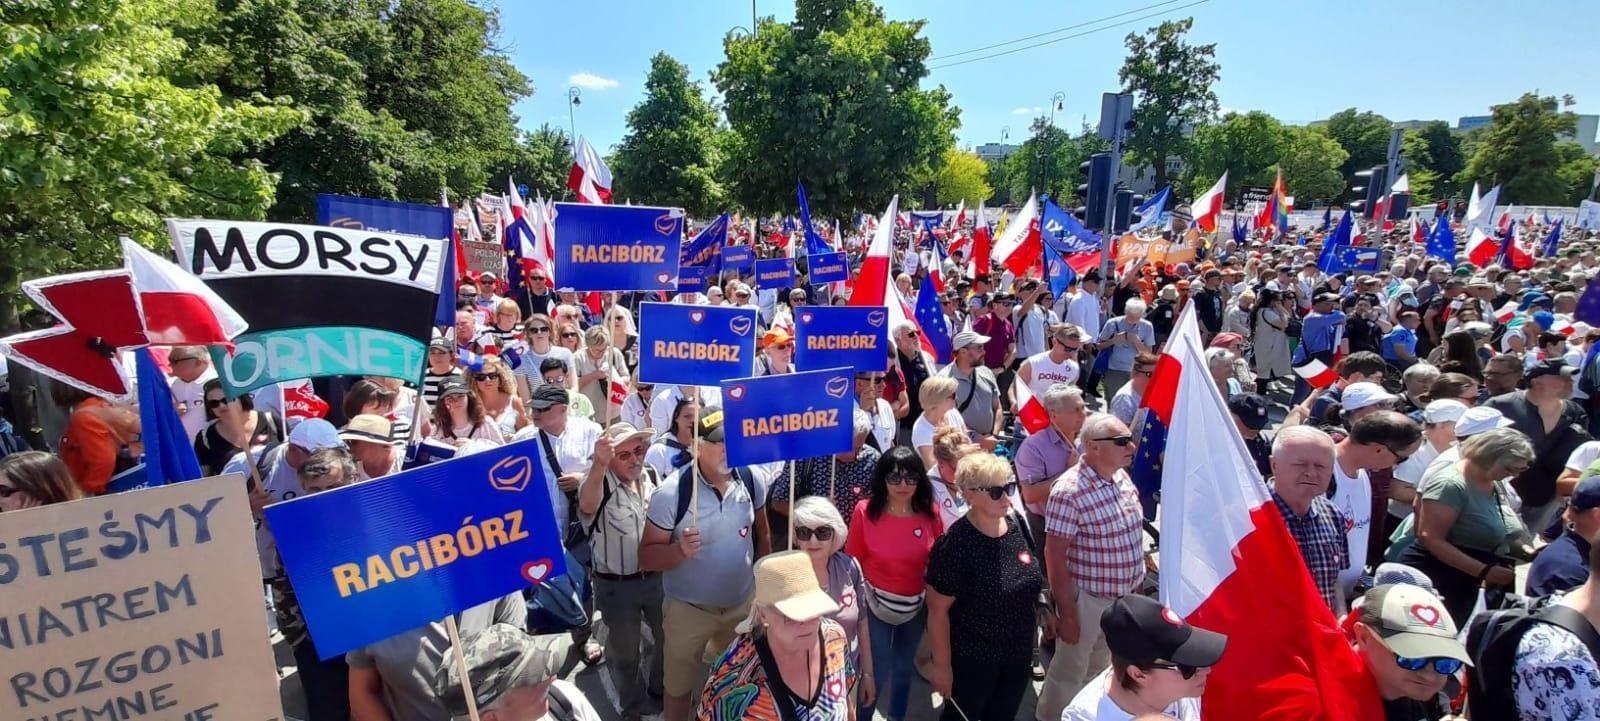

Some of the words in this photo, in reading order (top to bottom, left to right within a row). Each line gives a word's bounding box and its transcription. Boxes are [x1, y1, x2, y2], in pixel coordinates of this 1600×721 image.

[192, 227, 429, 281] MORSY
[571, 240, 666, 263] RACIBÓRZ
[654, 339, 740, 362] RACIBÓRZ
[807, 331, 877, 350] RACIBÓRZ
[1038, 371, 1068, 382] polska
[742, 407, 838, 437] RACIBÓRZ
[331, 509, 530, 598] RACIBÓRZ
[10, 628, 224, 707] ROZGONI
